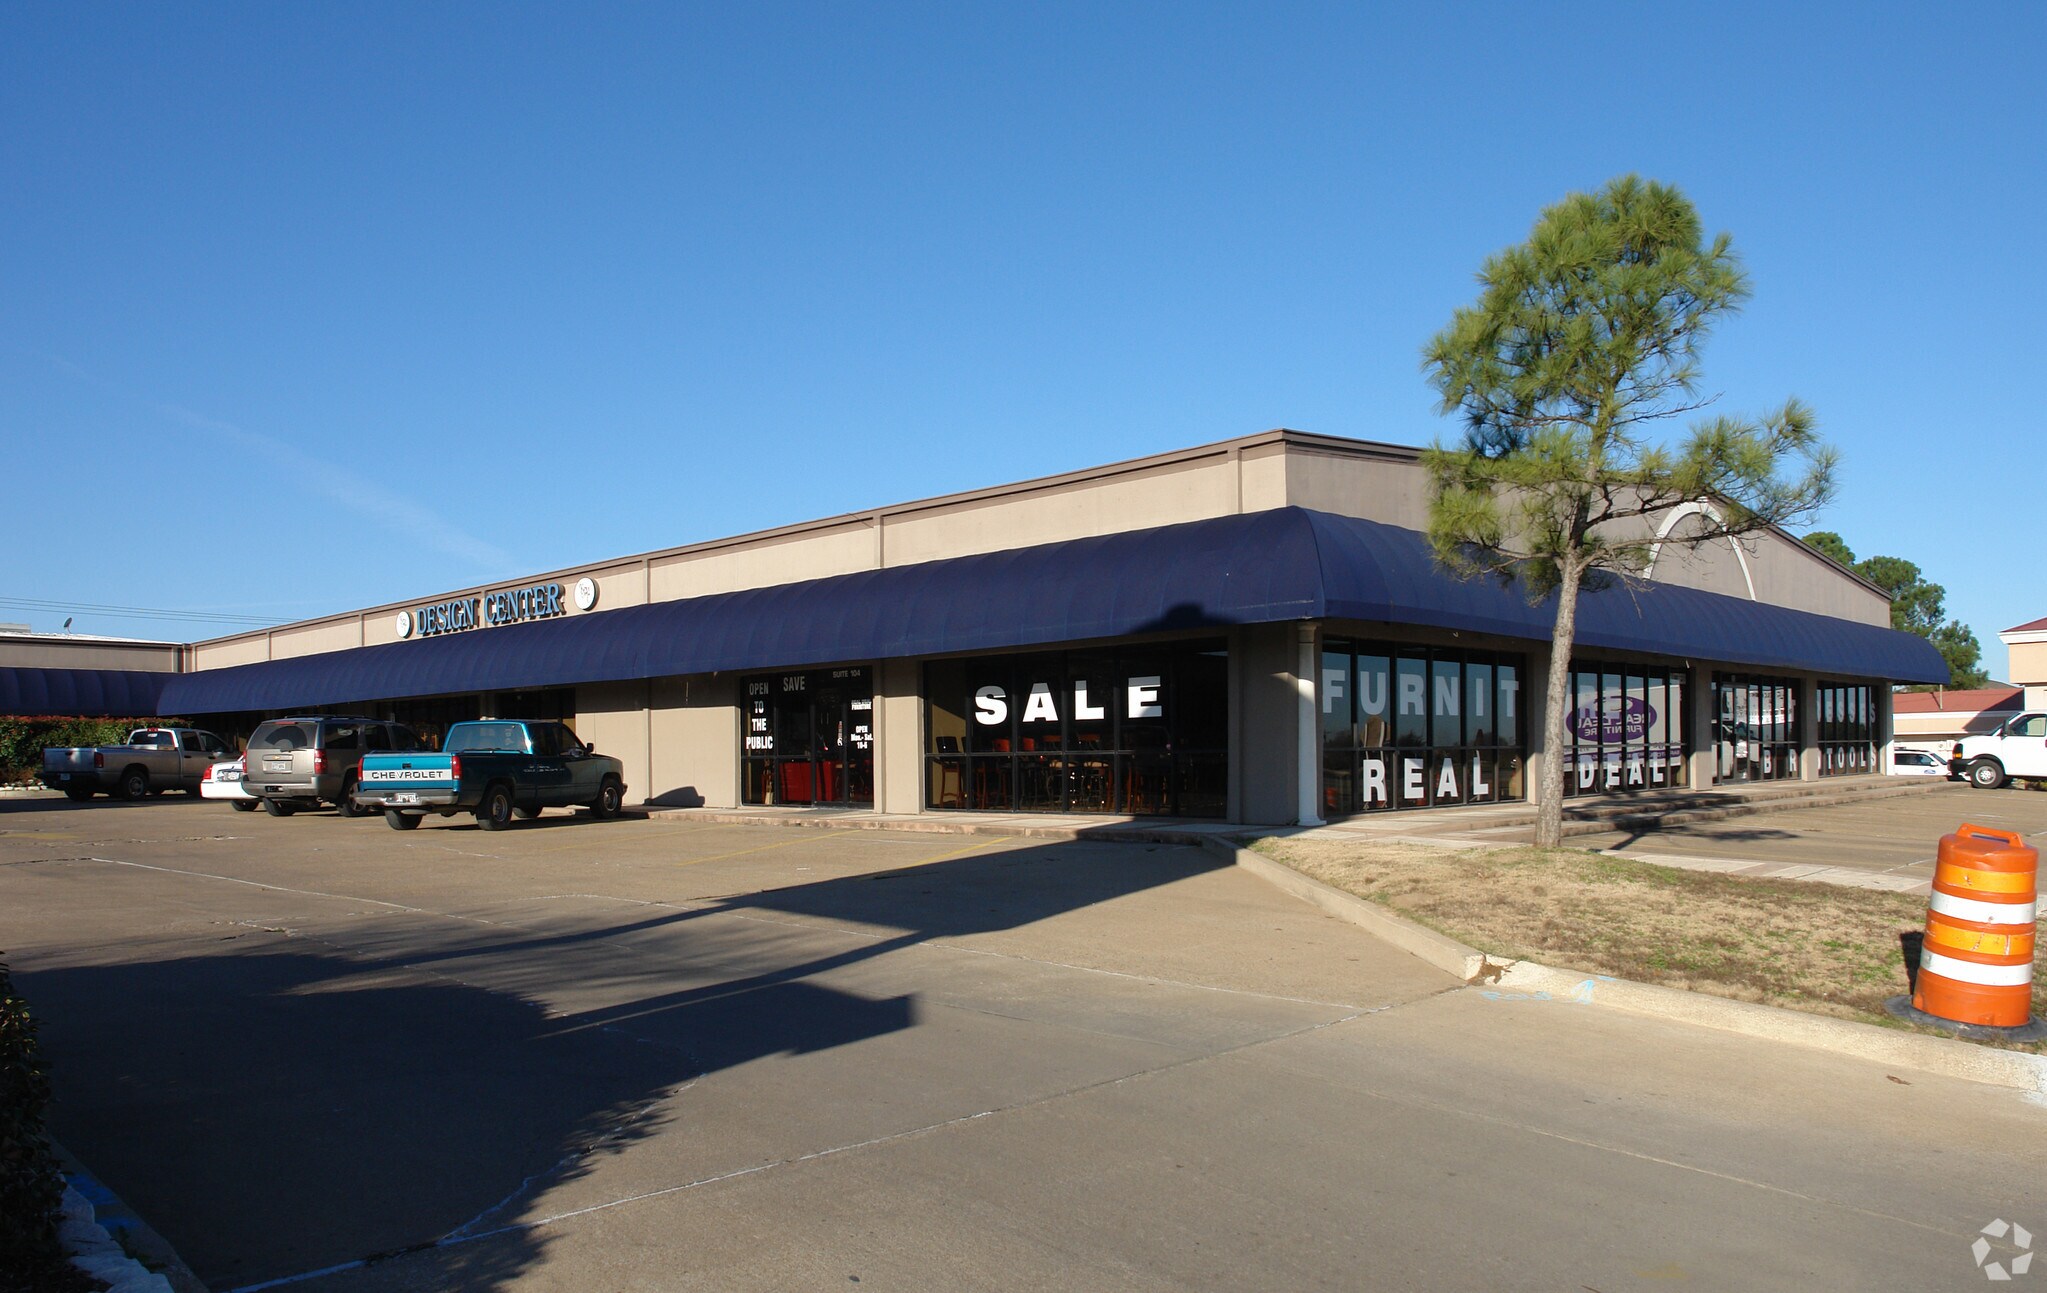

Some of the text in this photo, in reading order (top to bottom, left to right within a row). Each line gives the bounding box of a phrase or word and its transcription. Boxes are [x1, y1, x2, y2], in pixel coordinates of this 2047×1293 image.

[416, 598, 476, 634] DESIGN
[484, 583, 561, 623] CENTER
[832, 670, 848, 678] SUITE
[749, 682, 769, 695] OPEN
[783, 676, 806, 691] SAVE
[754, 700, 764, 713] TO
[975, 675, 1162, 725] SALE
[751, 718, 767, 731] THE
[746, 736, 773, 749] PUBLIC
[371, 771, 443, 779] CHEVROLET
[1363, 752, 1664, 802] REAL DEAL
